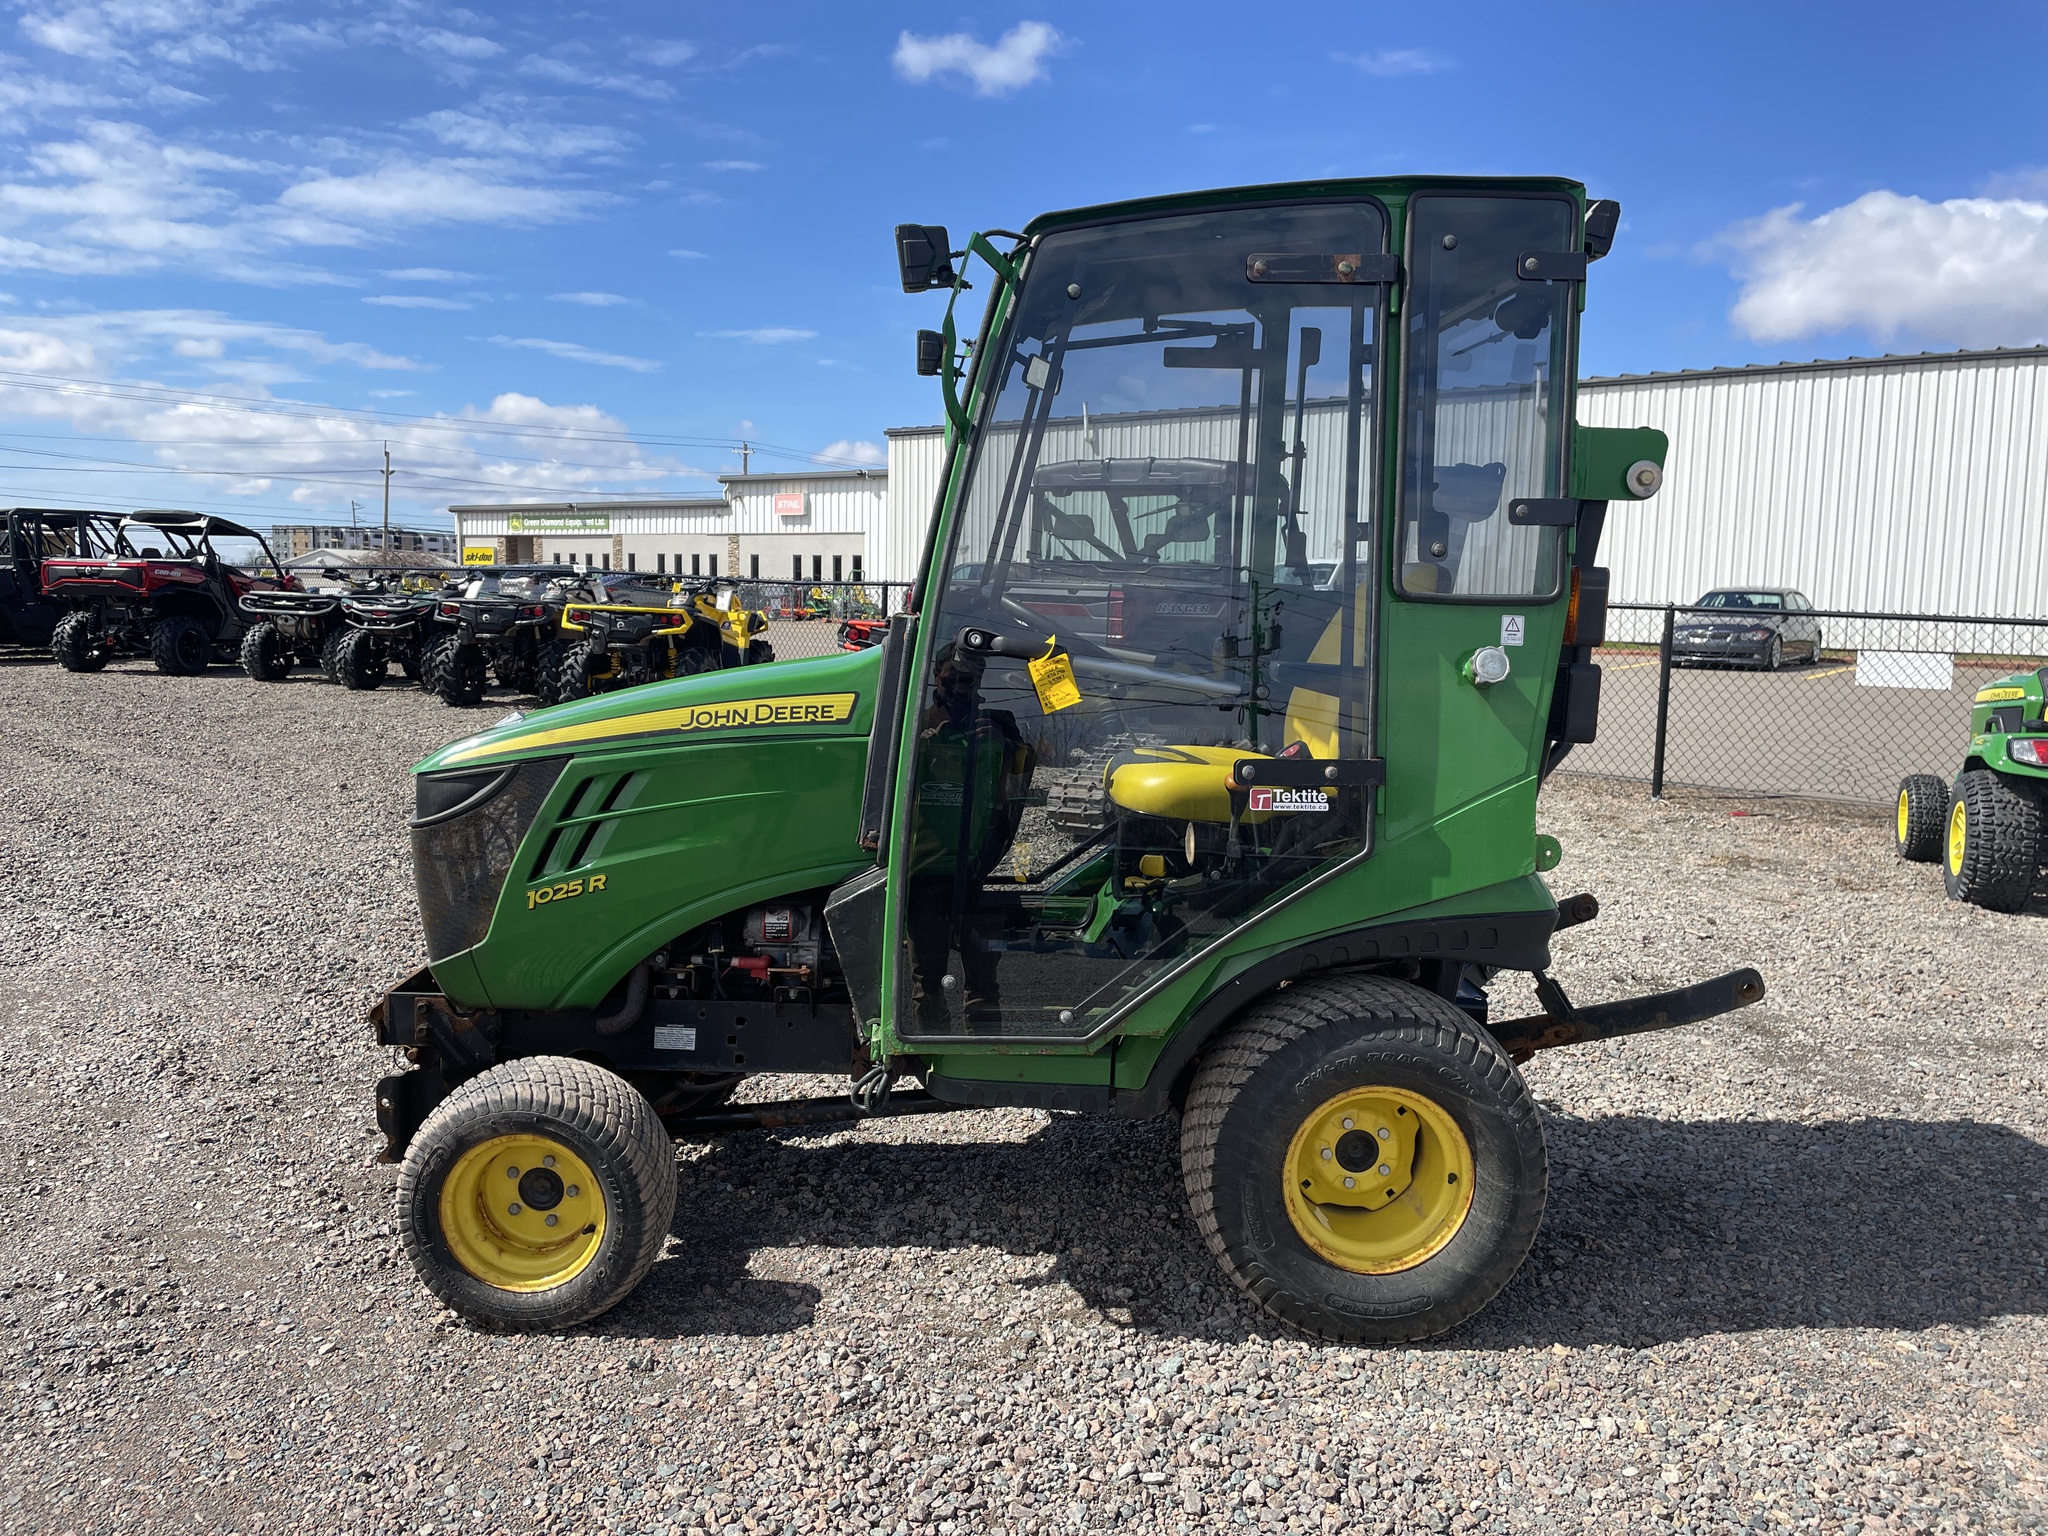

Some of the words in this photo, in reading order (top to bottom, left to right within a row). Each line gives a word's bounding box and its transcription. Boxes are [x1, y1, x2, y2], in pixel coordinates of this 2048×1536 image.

[777, 500, 800, 509] STIHL
[523, 518, 540, 526] Green
[541, 518, 564, 526] Diamond
[565, 518, 594, 528] Equipent
[1156, 603, 1211, 614] RANGER
[680, 708, 750, 728] JOHN
[755, 704, 836, 722] DEERE
[1272, 788, 1328, 803] Tektite
[527, 879, 584, 910] 1025
[588, 874, 608, 893] R
[1295, 1055, 1358, 1094] MULTI
[1366, 1051, 1432, 1066] TRAC
